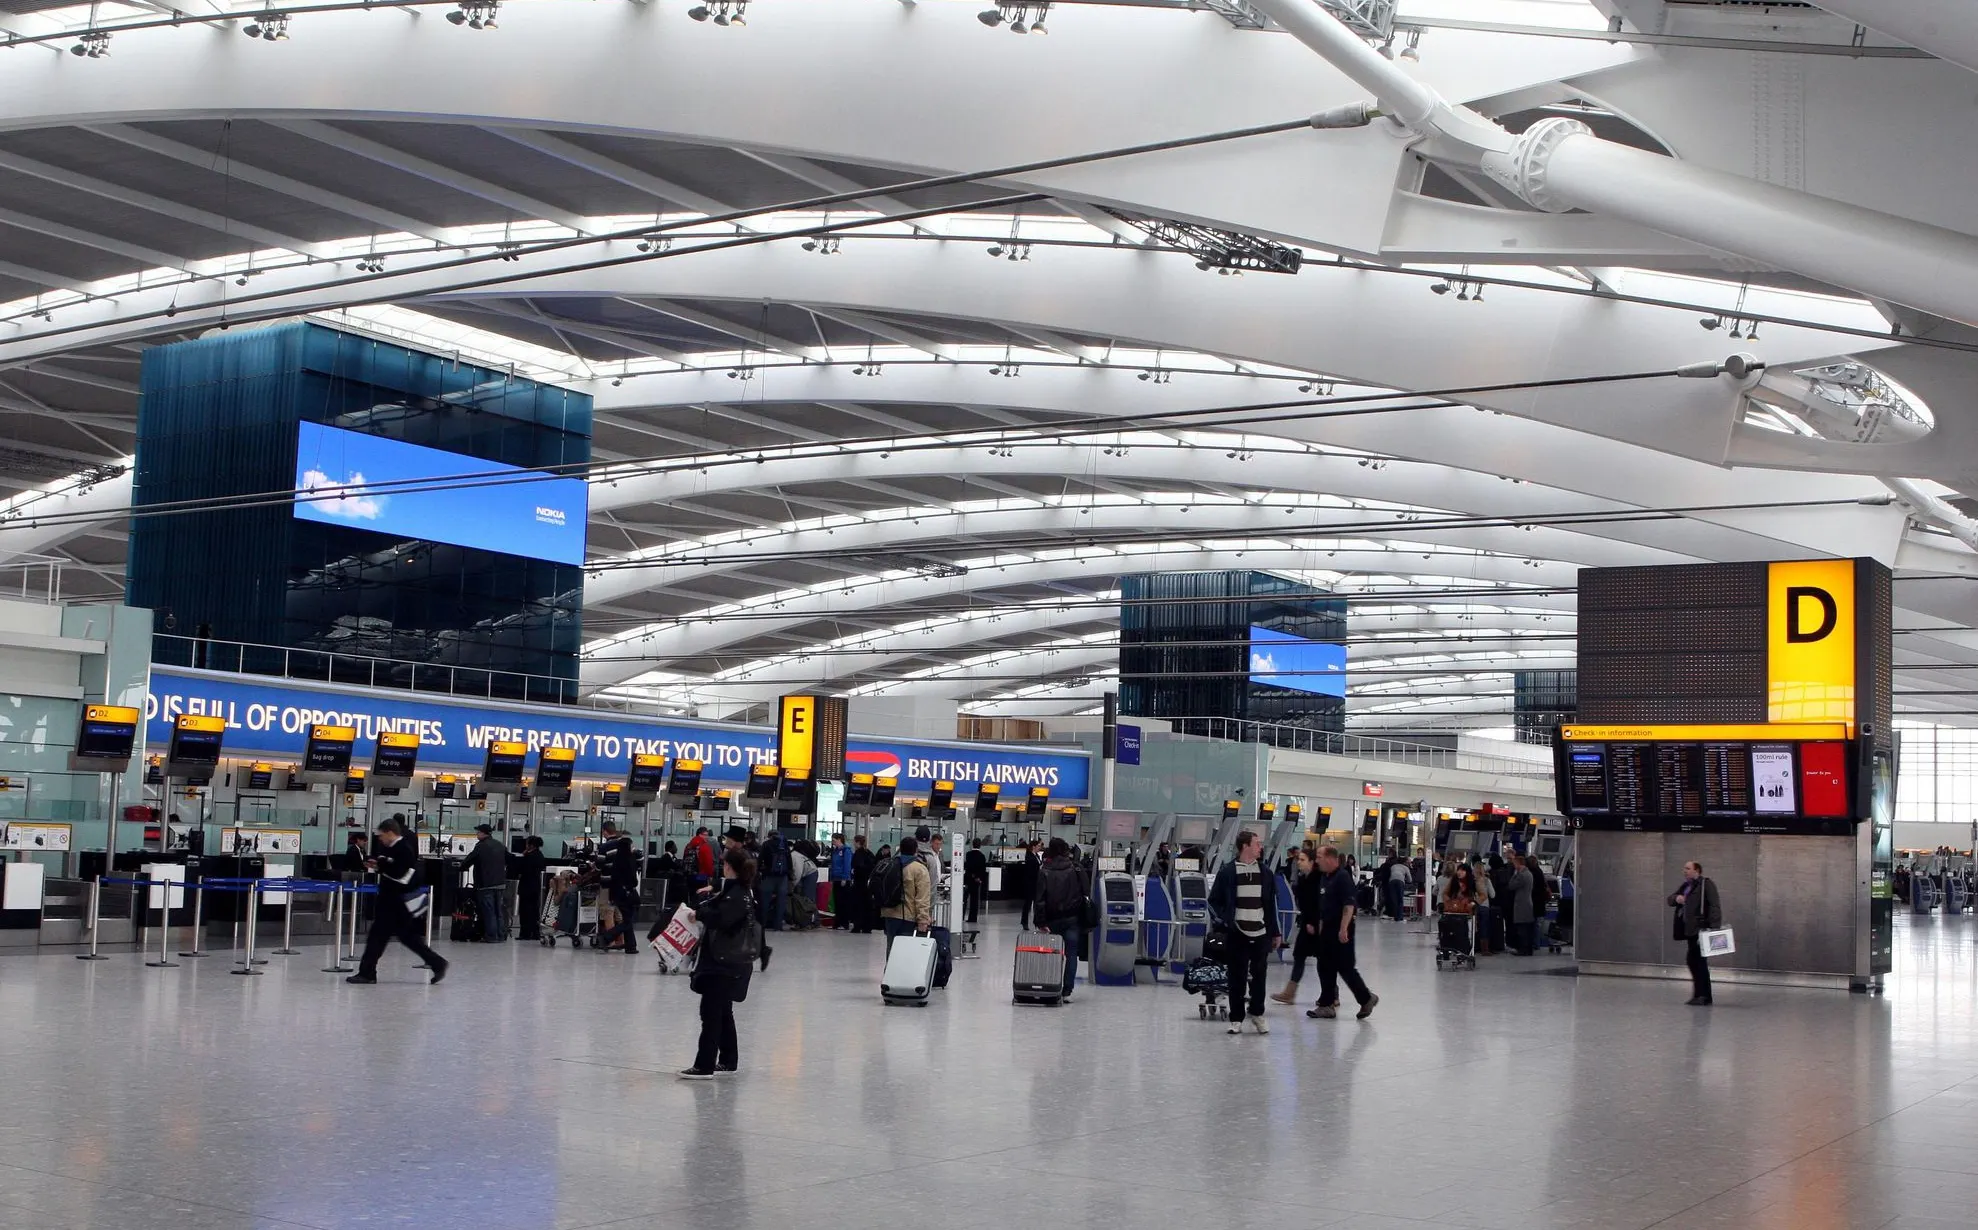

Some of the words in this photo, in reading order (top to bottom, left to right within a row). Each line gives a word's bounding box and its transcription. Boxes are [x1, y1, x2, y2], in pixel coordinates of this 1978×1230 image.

[536, 506, 565, 519] NOKIA
[1786, 586, 1838, 644] D
[163, 695, 184, 722] IS
[188, 697, 242, 728] FULL
[246, 703, 279, 731] OF
[527, 729, 591, 756] READY
[594, 735, 620, 759] TO
[624, 737, 670, 762] TAKE
[674, 741, 712, 765] YOU
[715, 744, 742, 767] TO
[791, 707, 805, 733] E
[1608, 729, 1652, 737] information
[324, 754, 334, 762] drop
[908, 758, 979, 782] BRITISH
[983, 764, 1059, 786] AIRWAYS
